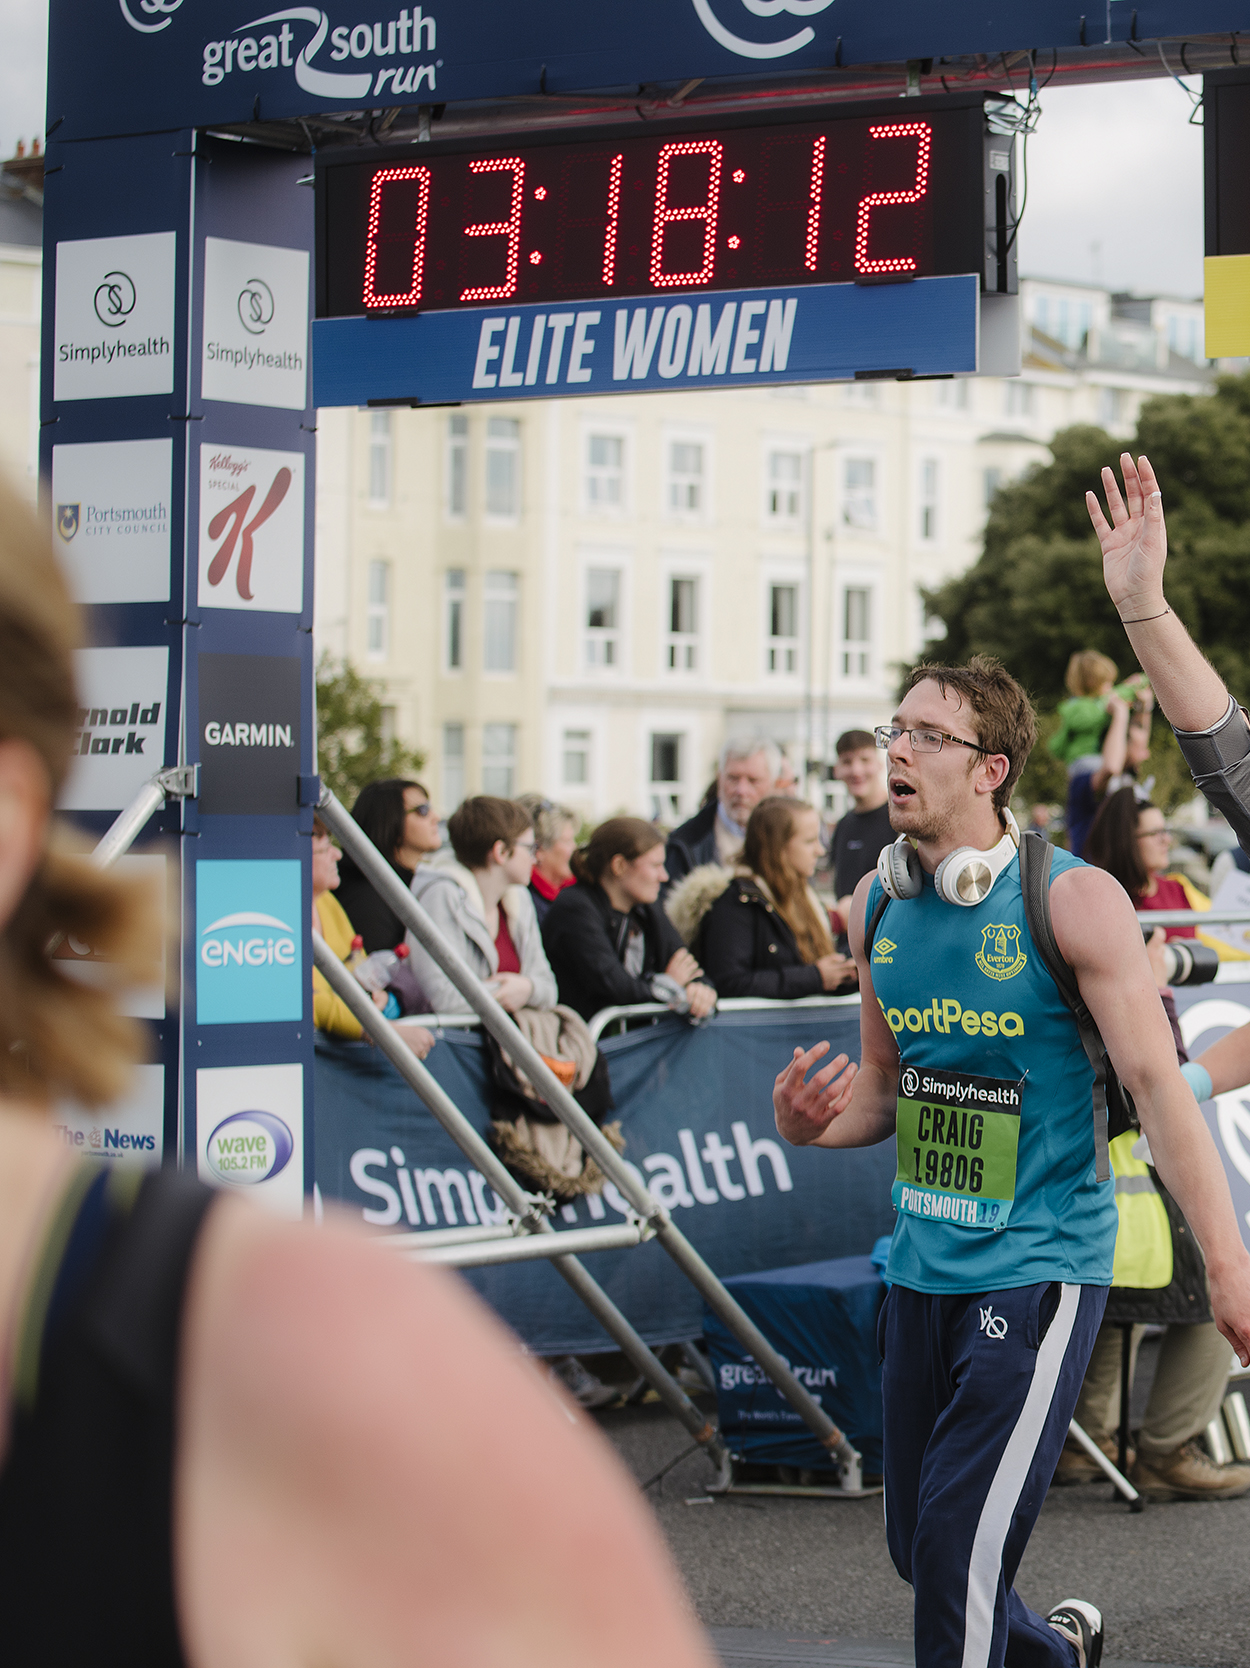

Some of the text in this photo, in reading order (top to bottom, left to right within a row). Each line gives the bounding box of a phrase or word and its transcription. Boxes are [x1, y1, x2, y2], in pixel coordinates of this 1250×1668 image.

[202, 5, 437, 86] great south
[373, 62, 437, 96] run
[362, 122, 932, 308] 03:18:12
[58, 336, 170, 364] Simplyhealth
[205, 341, 303, 372] Simplyhealth
[471, 298, 799, 390] ELITE WOMEN
[208, 480, 240, 492] SPECIAL
[85, 502, 168, 523] Portsmouth
[85, 522, 168, 536] CITY COUNCIL
[207, 466, 292, 601] K
[78, 702, 162, 727] rnold
[873, 955, 894, 964] umbro
[987, 953, 1014, 963] Everton
[921, 1076, 1020, 1106] Simplyhealth
[52, 1125, 156, 1151] The News
[917, 1105, 985, 1150] CRAIG
[217, 1135, 267, 1155] wave
[217, 1155, 268, 1172] 105.2 FM
[912, 1147, 985, 1193] 19806
[900, 1186, 1001, 1224] PORTSMOUTH 19
[793, 1365, 838, 1388] run
